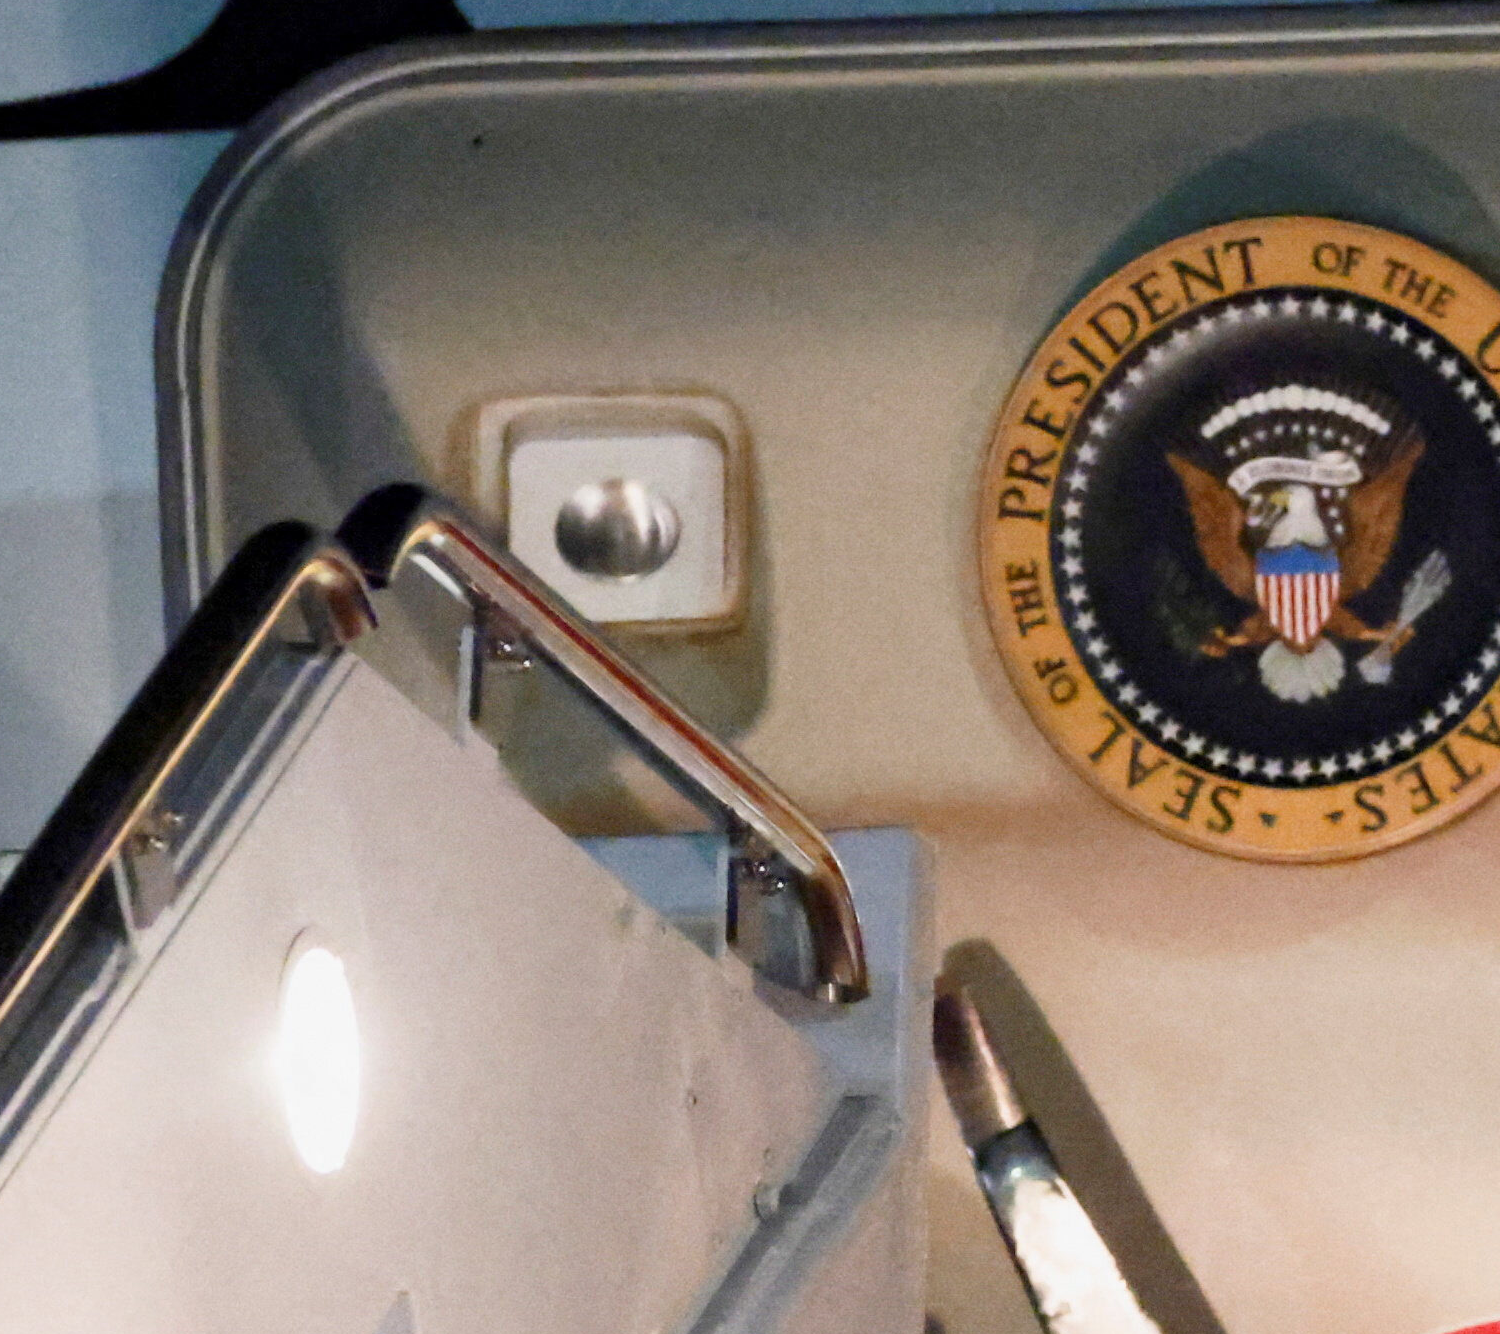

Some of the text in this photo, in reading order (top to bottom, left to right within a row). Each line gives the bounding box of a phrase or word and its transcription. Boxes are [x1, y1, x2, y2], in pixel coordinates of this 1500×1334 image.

[1312, 242, 1365, 277] OF
[1383, 258, 1455, 317] THE
[999, 238, 1262, 523] PRESIDENT
[1004, 560, 1049, 637] THE
[1034, 657, 1079, 704] OF
[1089, 720, 1242, 834] SEAL
